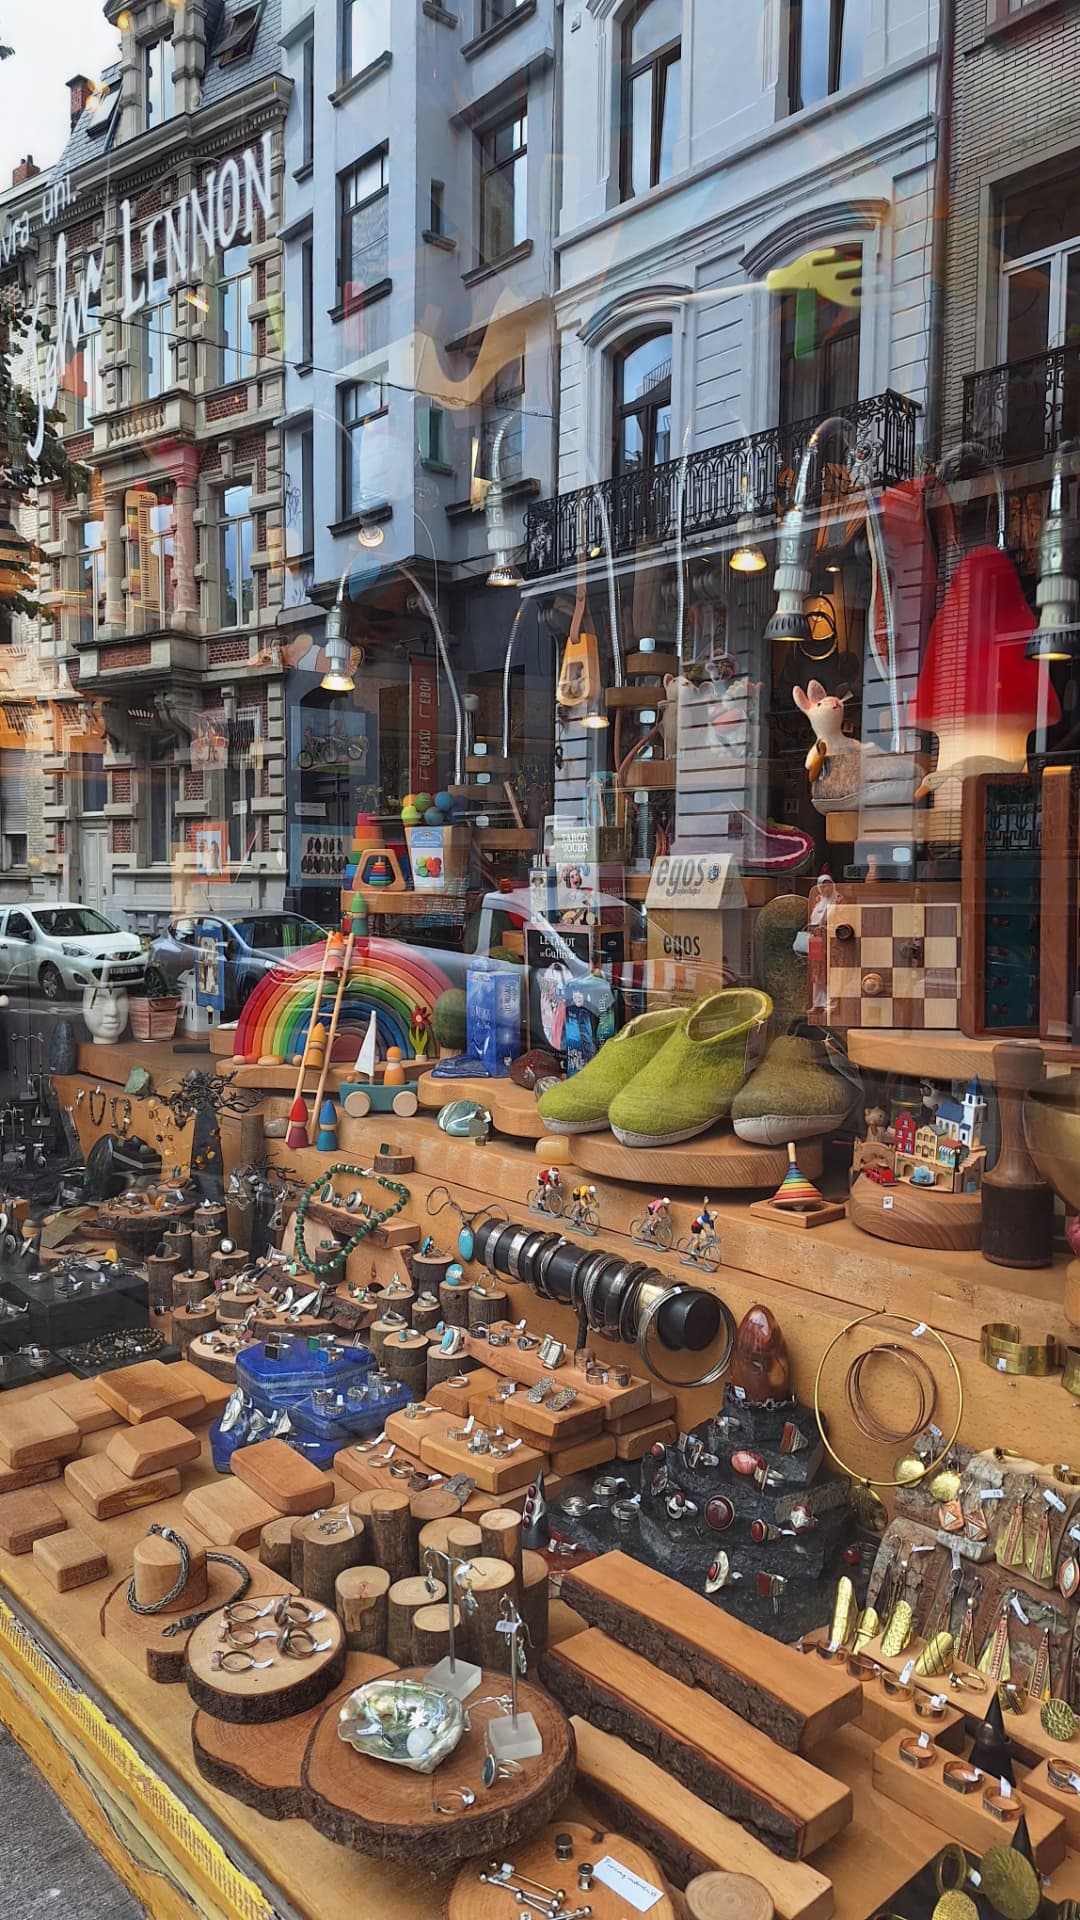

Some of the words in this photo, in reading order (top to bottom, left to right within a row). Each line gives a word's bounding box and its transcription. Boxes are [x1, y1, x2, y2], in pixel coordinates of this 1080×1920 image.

[0, 210, 30, 268] vra
[119, 131, 278, 322] LENNON
[560, 833, 589, 843] TAROT
[656, 858, 706, 897] egos
[663, 935, 701, 961] egos
